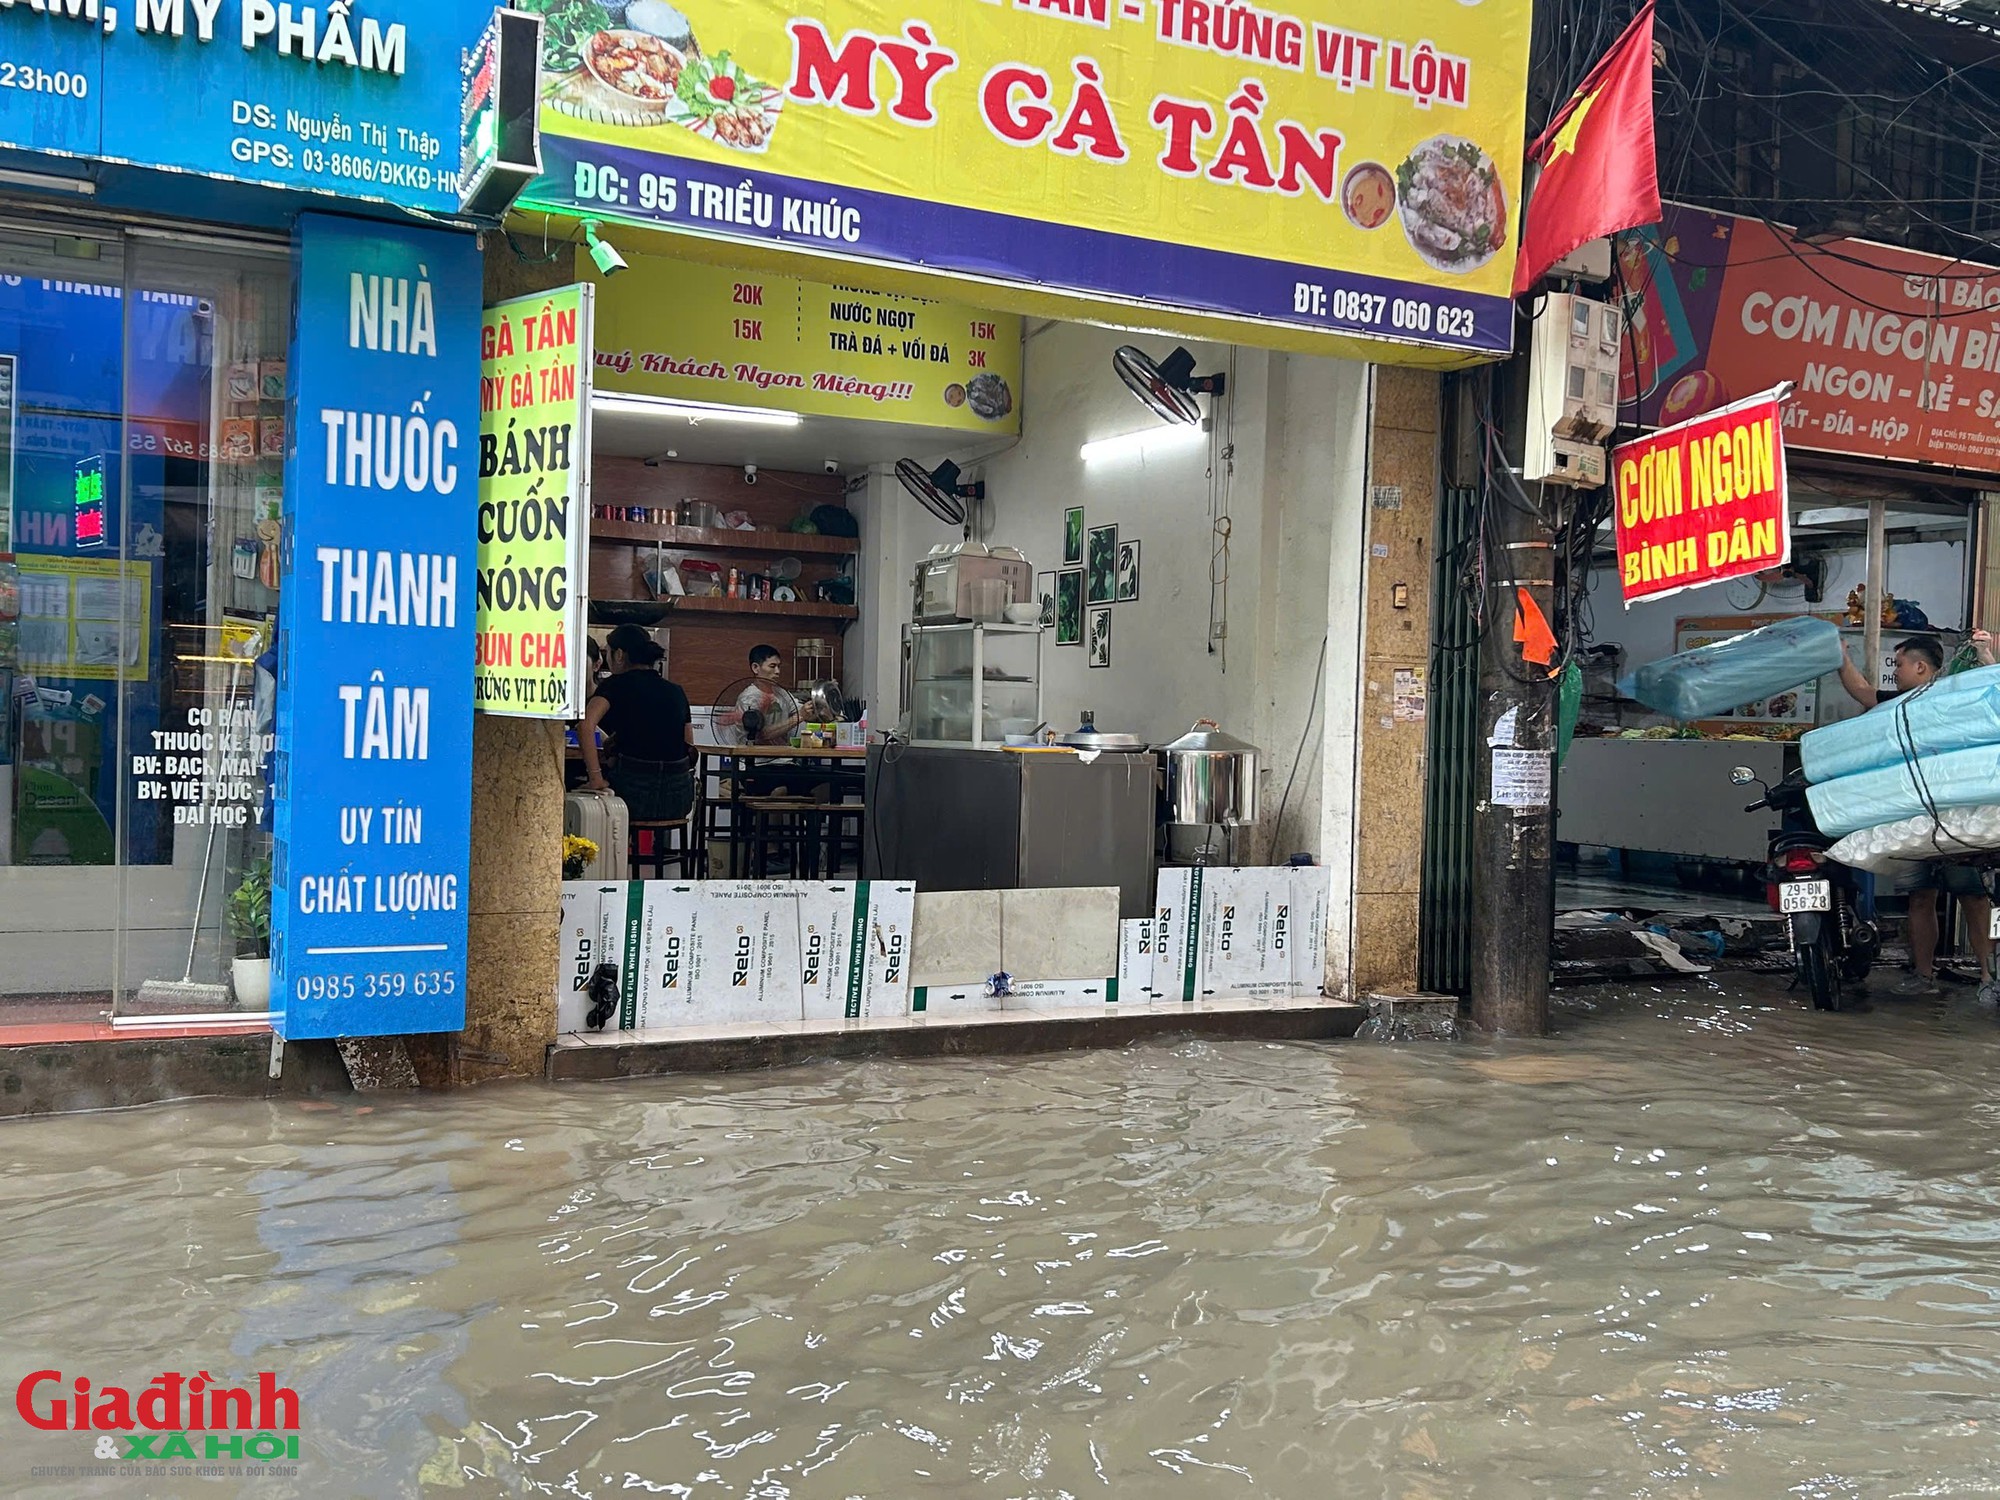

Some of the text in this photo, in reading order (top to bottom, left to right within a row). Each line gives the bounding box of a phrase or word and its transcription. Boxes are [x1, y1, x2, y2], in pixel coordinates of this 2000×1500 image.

[1157, 0, 1466, 104] TRỨNG VỊT LỘN
[232, 100, 440, 161] DS: Nguyễn Thị Thập
[790, 24, 1341, 199] MỲ GÀ TẦN
[231, 137, 294, 169] GPS:
[574, 161, 861, 243] ĐC: 95 TRIỀU KHÚC
[349, 264, 437, 357] NHÀ
[732, 283, 763, 306] 20K
[1294, 282, 1474, 338] ĐT: 0837 060 623
[482, 300, 576, 361] GÀ TẦN
[733, 318, 762, 341] 15K
[830, 301, 996, 340] NƯỚC NGỌT 15K
[1741, 291, 1840, 347] CƠM
[1843, 308, 1959, 366] NGON
[829, 331, 858, 353] TRÀ
[862, 334, 883, 355] ĐÁ
[902, 336, 925, 361] VỐI
[930, 344, 949, 363] ĐÁ
[968, 350, 986, 368] 3K
[481, 353, 575, 413] MỲ GÀ TẦN
[640, 353, 728, 379] Khách
[734, 364, 805, 389] Ngon
[813, 373, 914, 401] Miệng!!!
[1802, 362, 1894, 403] NGON
[321, 390, 458, 495] THUỐC
[479, 418, 571, 477] BÁNH
[1823, 409, 1854, 435] ĐĨA
[1869, 416, 1909, 446] HỘP
[1620, 418, 1774, 529] CƠM NGON
[478, 477, 570, 545] CUỐN
[1625, 517, 1777, 587] BÌNH DÂN
[317, 547, 456, 628] THANH
[476, 555, 567, 612] NÓNG
[475, 620, 567, 668] BÚN CHẢ
[339, 669, 430, 760] TÂM
[474, 670, 567, 711] RỨNG VỊT LỘN
[133, 756, 161, 775] BV:
[138, 781, 167, 799] BV:
[171, 778, 211, 803] VIỆT
[210, 806, 247, 828] HỌC
[340, 799, 422, 844] UY TÍN
[300, 859, 457, 921] CHẤT LƯỢNG
[1787, 883, 1822, 896] 29-BN
[630, 919, 638, 944] USING
[852, 918, 864, 985] FILM WHEN USING
[1158, 907, 1172, 954] Reto
[1221, 906, 1234, 951] Reto
[1275, 905, 1288, 949] Reto
[574, 939, 591, 992] Reto
[662, 937, 680, 988] Reto
[732, 935, 750, 986] Reto
[803, 935, 821, 984] Reto
[885, 934, 902, 983] Reto
[296, 970, 456, 1001] 0985 359 635
